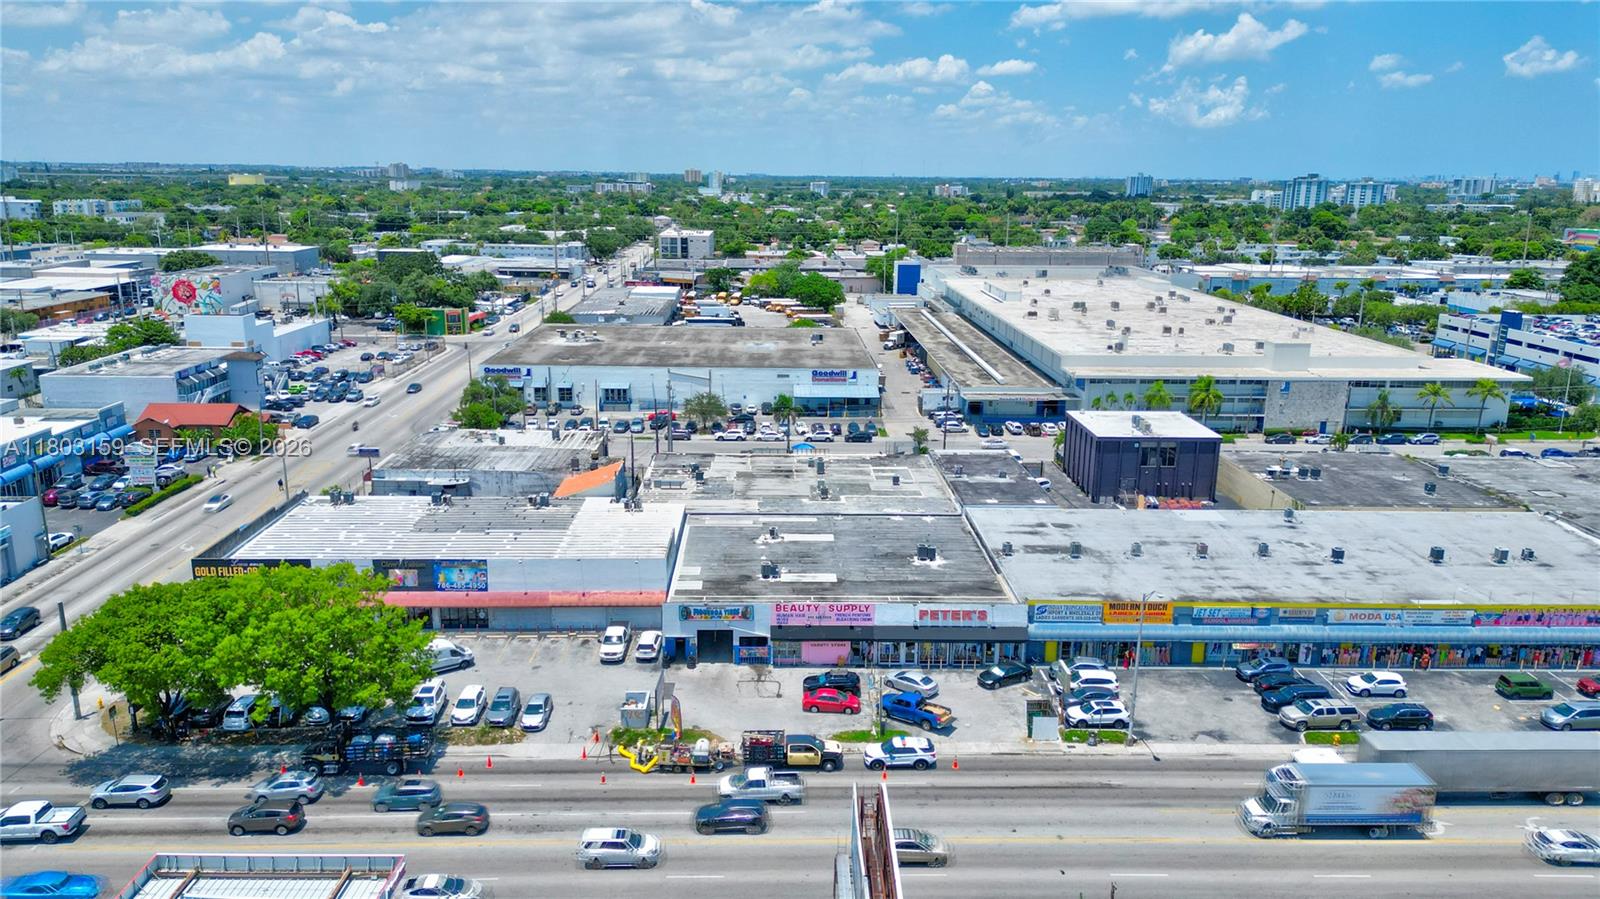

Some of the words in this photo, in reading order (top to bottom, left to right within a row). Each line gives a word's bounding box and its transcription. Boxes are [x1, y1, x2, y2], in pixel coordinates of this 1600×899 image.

[194, 566, 217, 577] GOLD
[775, 604, 820, 612] BEAUTY
[828, 604, 871, 613] SUPPLY
[1109, 602, 1141, 611] MODERN
[918, 609, 988, 621] PETER'S
[1208, 608, 1221, 618] SET
[1349, 612, 1382, 621] MODA
[1384, 612, 1402, 621] USA
